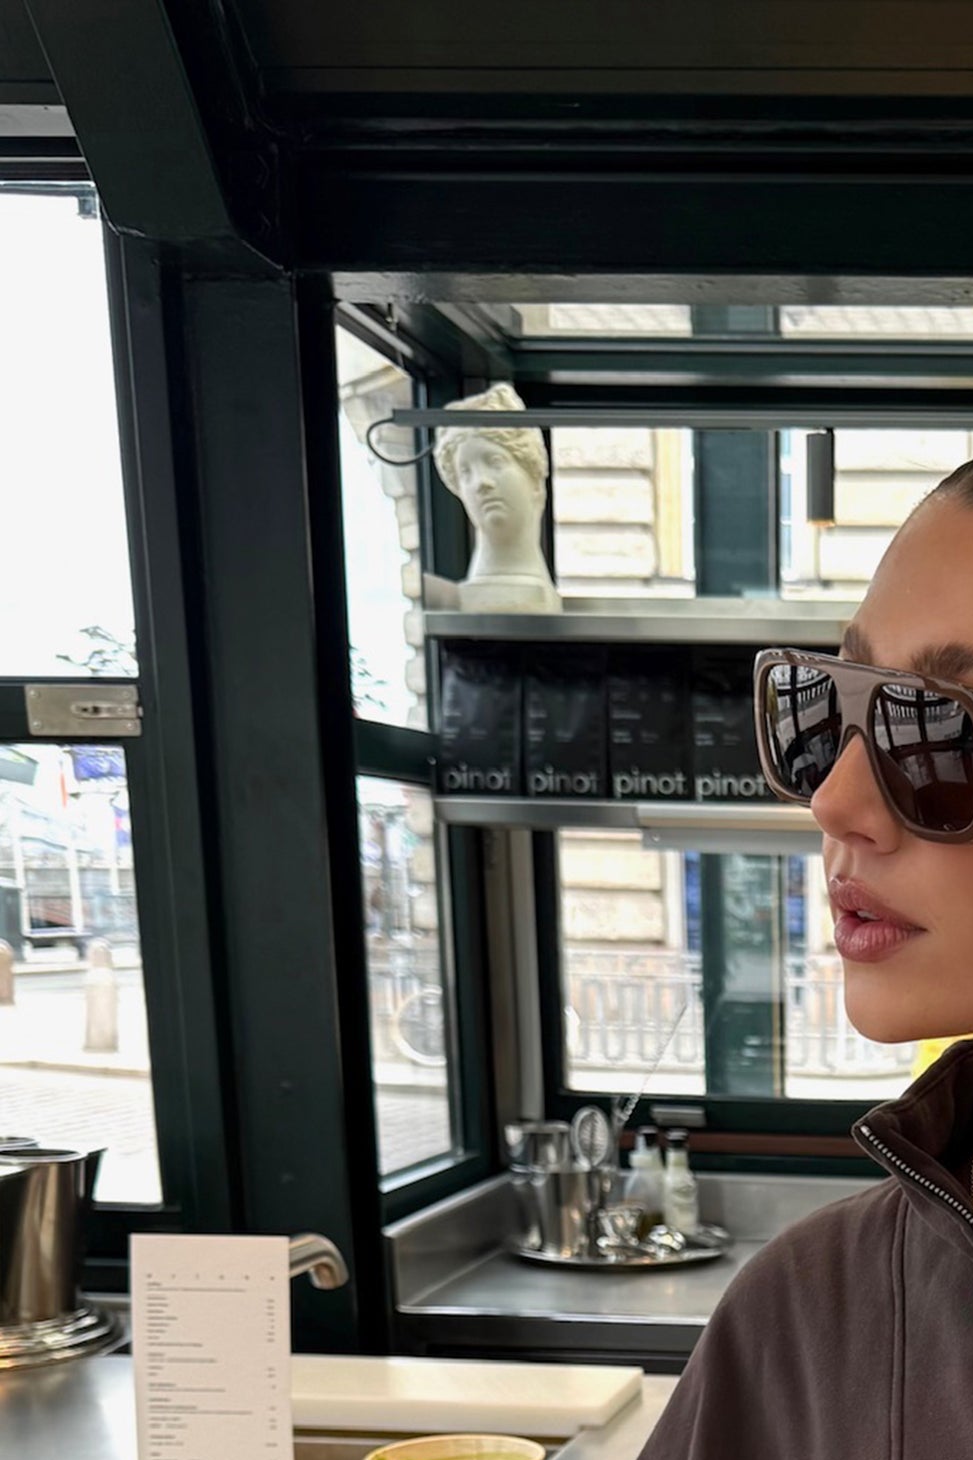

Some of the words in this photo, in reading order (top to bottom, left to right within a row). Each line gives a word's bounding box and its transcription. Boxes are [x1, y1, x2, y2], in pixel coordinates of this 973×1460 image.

[530, 764, 599, 796] pinot
[613, 766, 687, 798] pinot
[695, 767, 766, 801] pinot
